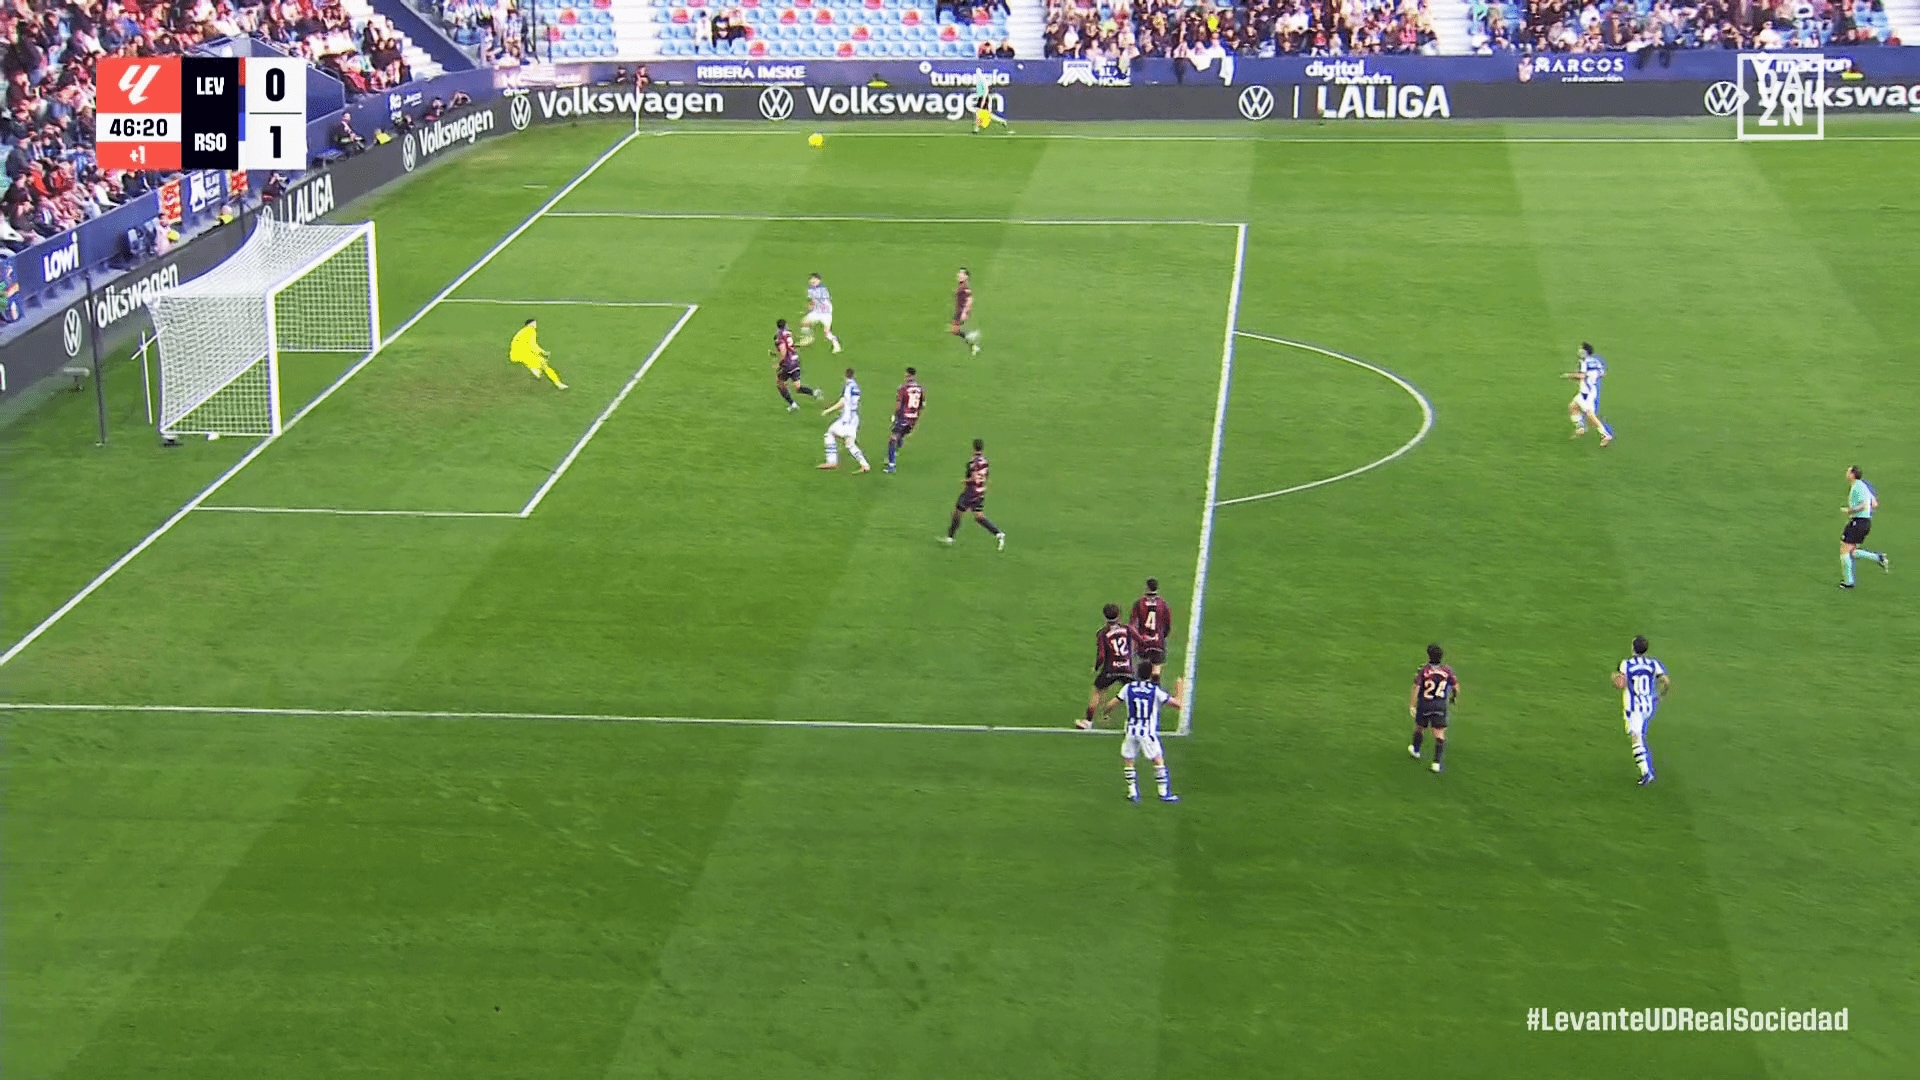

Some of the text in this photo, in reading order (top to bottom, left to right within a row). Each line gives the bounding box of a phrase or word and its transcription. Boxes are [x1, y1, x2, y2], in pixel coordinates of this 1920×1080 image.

[1305, 59, 1365, 82] digital
[1534, 57, 1624, 73] MARCOS
[537, 86, 724, 120] Volkswagen
[806, 86, 1004, 121] Volkswagen
[1317, 84, 1451, 119] LALIGA
[418, 109, 494, 156] Volkswagen
[287, 173, 334, 230] LALIGA
[1144, 611, 1157, 631] 4
[1110, 637, 1129, 656] 12
[1423, 679, 1448, 699] 24
[1631, 674, 1651, 696] 10
[1132, 698, 1149, 720] 11
